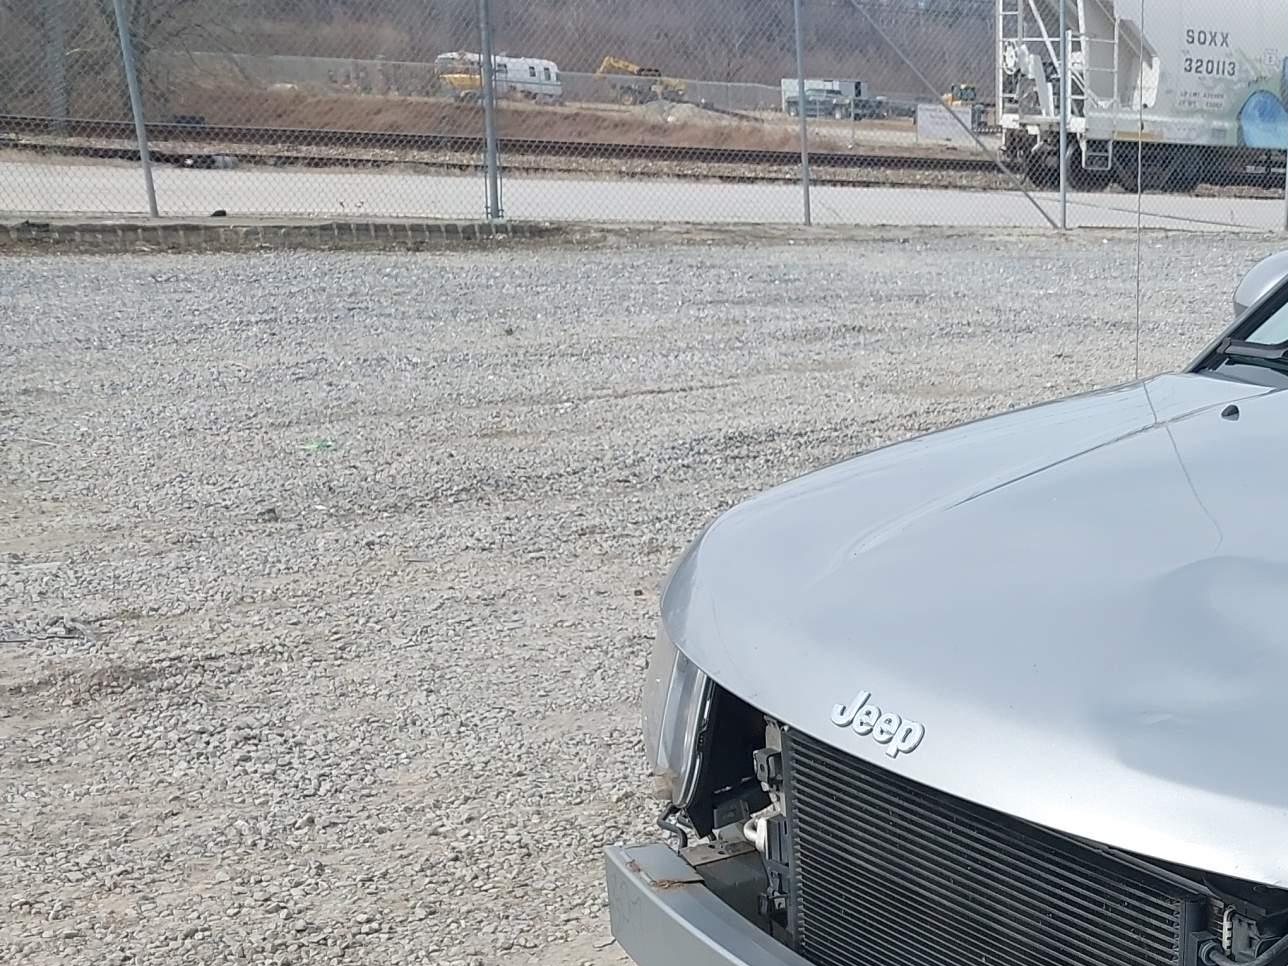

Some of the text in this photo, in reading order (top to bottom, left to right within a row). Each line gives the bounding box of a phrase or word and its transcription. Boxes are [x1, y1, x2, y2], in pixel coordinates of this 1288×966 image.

[1186, 29, 1229, 48] SOXX
[1183, 57, 1236, 77] 320113
[831, 690, 926, 759] Jeep
